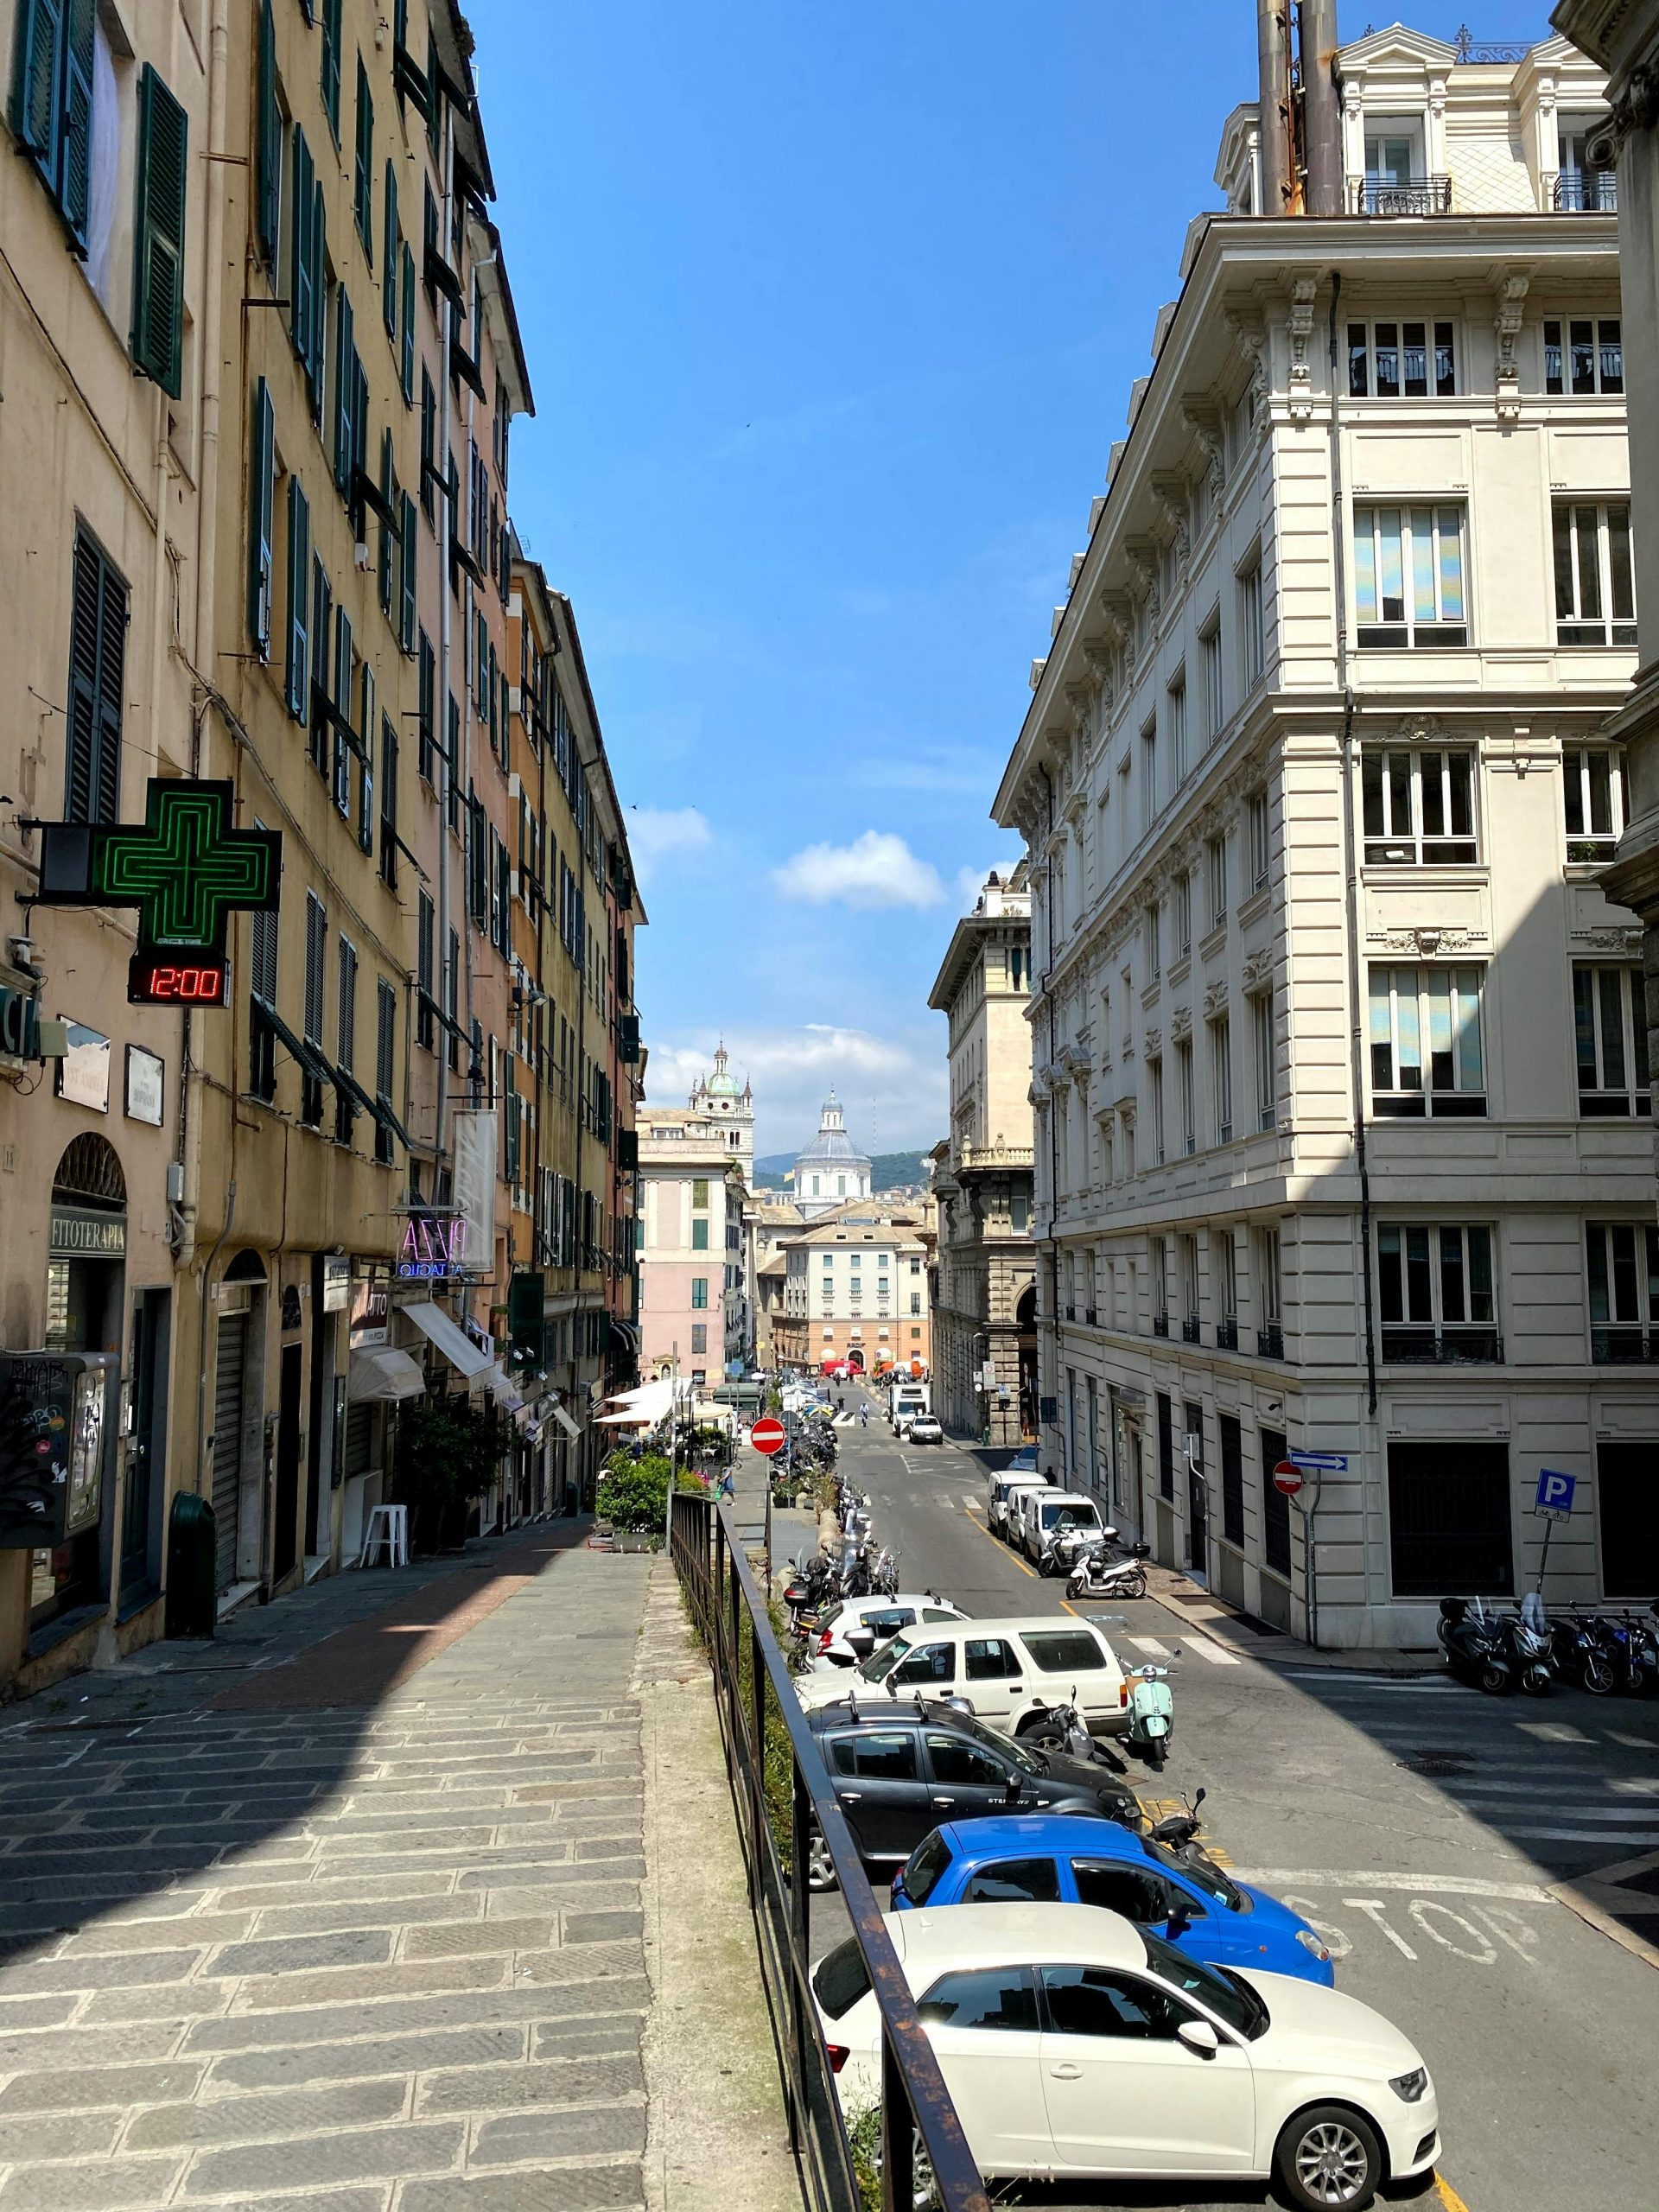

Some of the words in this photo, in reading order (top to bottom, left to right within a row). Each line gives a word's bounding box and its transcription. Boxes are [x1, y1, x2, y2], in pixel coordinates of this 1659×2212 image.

[150, 969, 218, 996] 12:00
[52, 1218, 124, 1249] FITOTERAPIA
[1544, 1475, 1567, 1502] P
[1281, 1894, 1541, 1967] STOP
